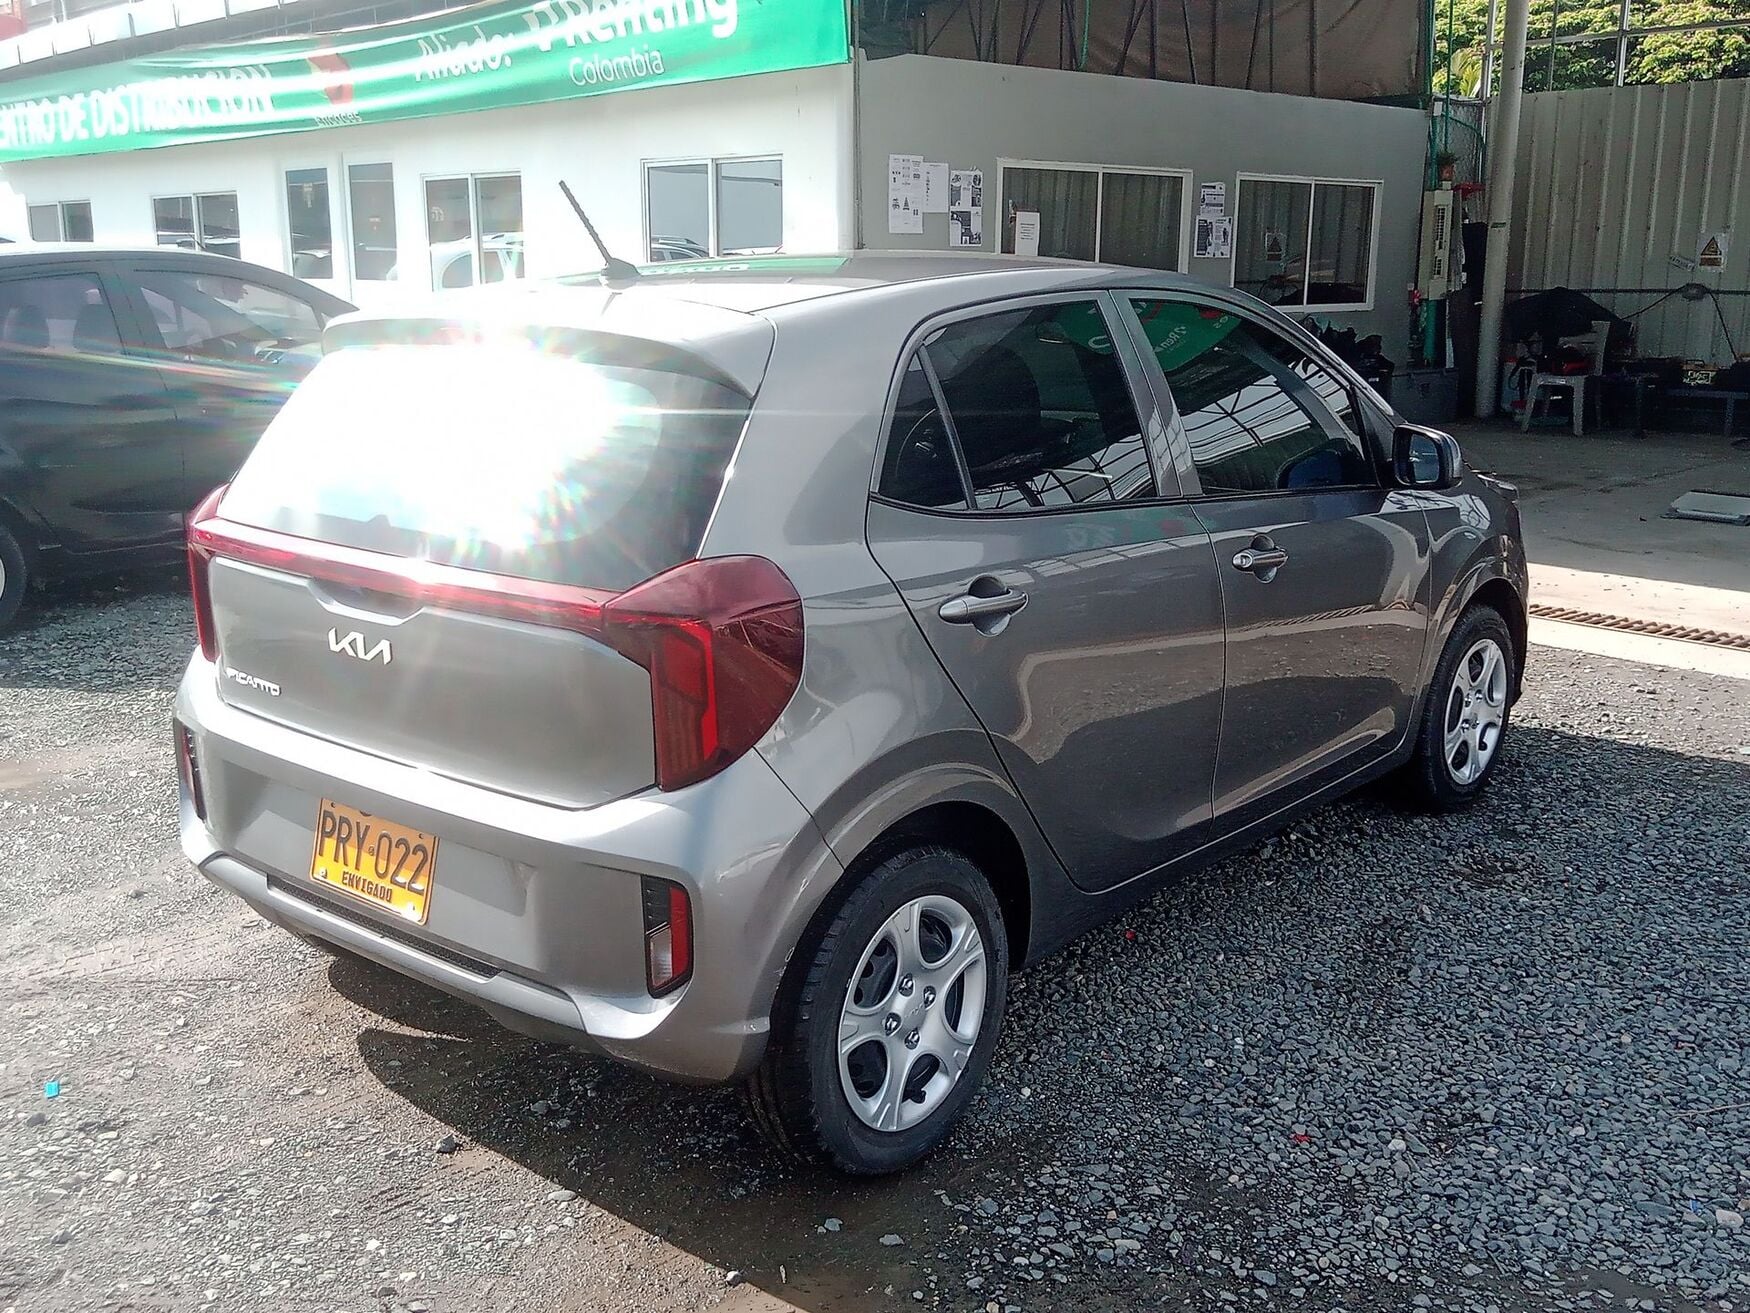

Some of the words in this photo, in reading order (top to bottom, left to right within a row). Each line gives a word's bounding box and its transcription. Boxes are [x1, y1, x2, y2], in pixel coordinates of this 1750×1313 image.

[568, 44, 665, 87] Colombia
[59, 92, 89, 143] DE
[328, 627, 393, 665] KIA
[226, 667, 282, 697] PICANTO
[319, 810, 371, 872] PRY
[374, 830, 429, 897] 022
[341, 870, 393, 904] ENVIGADO
